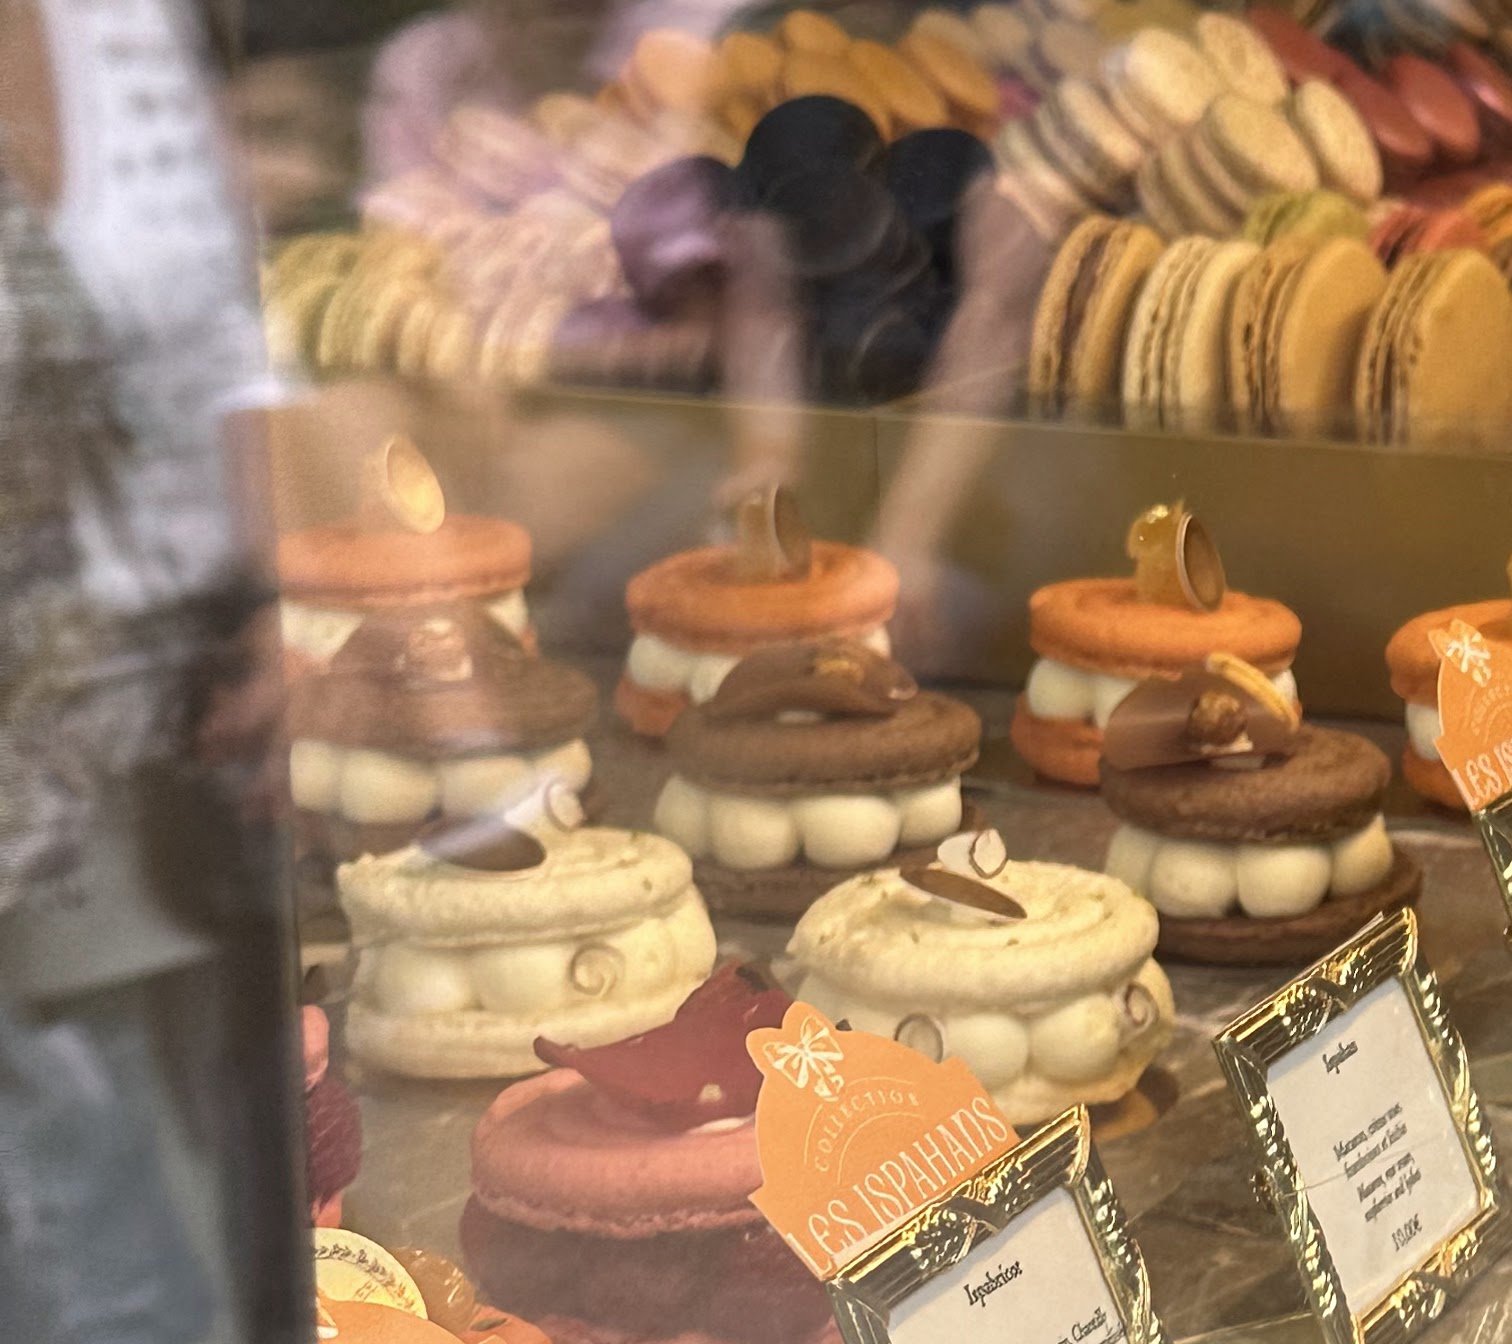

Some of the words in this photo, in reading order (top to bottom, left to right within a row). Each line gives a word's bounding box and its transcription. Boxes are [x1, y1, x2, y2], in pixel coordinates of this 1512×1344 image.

[1452, 753, 1503, 811] LES
[814, 1089, 919, 1172] COLLECTION
[786, 1199, 868, 1274] LES
[853, 1097, 1007, 1229] ISPAHANS
